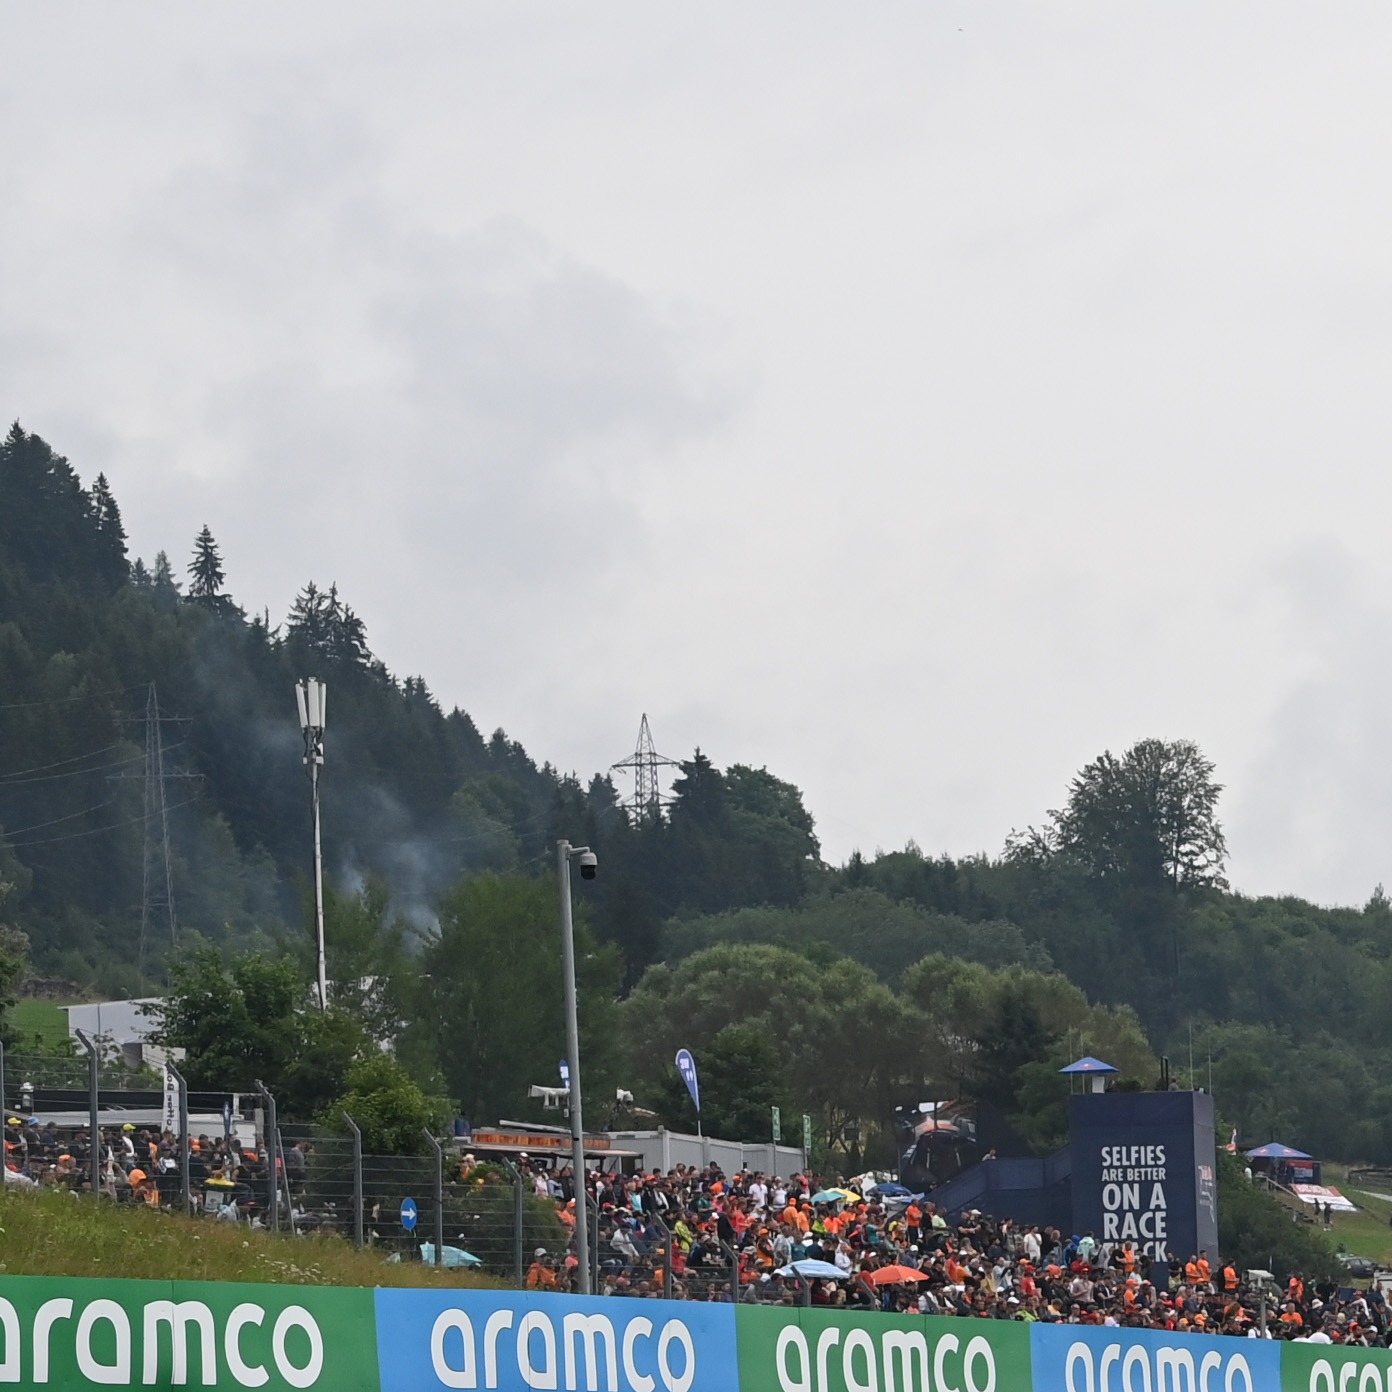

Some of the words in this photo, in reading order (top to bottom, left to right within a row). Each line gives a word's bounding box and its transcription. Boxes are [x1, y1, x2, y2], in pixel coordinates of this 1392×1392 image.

[1101, 1145, 1167, 1167] SELFIES
[1101, 1168, 1124, 1182] ARE
[1126, 1167, 1167, 1181] BETTER
[1102, 1183, 1140, 1211] ON
[1149, 1182, 1168, 1210] A
[1103, 1211, 1168, 1240] RACE
